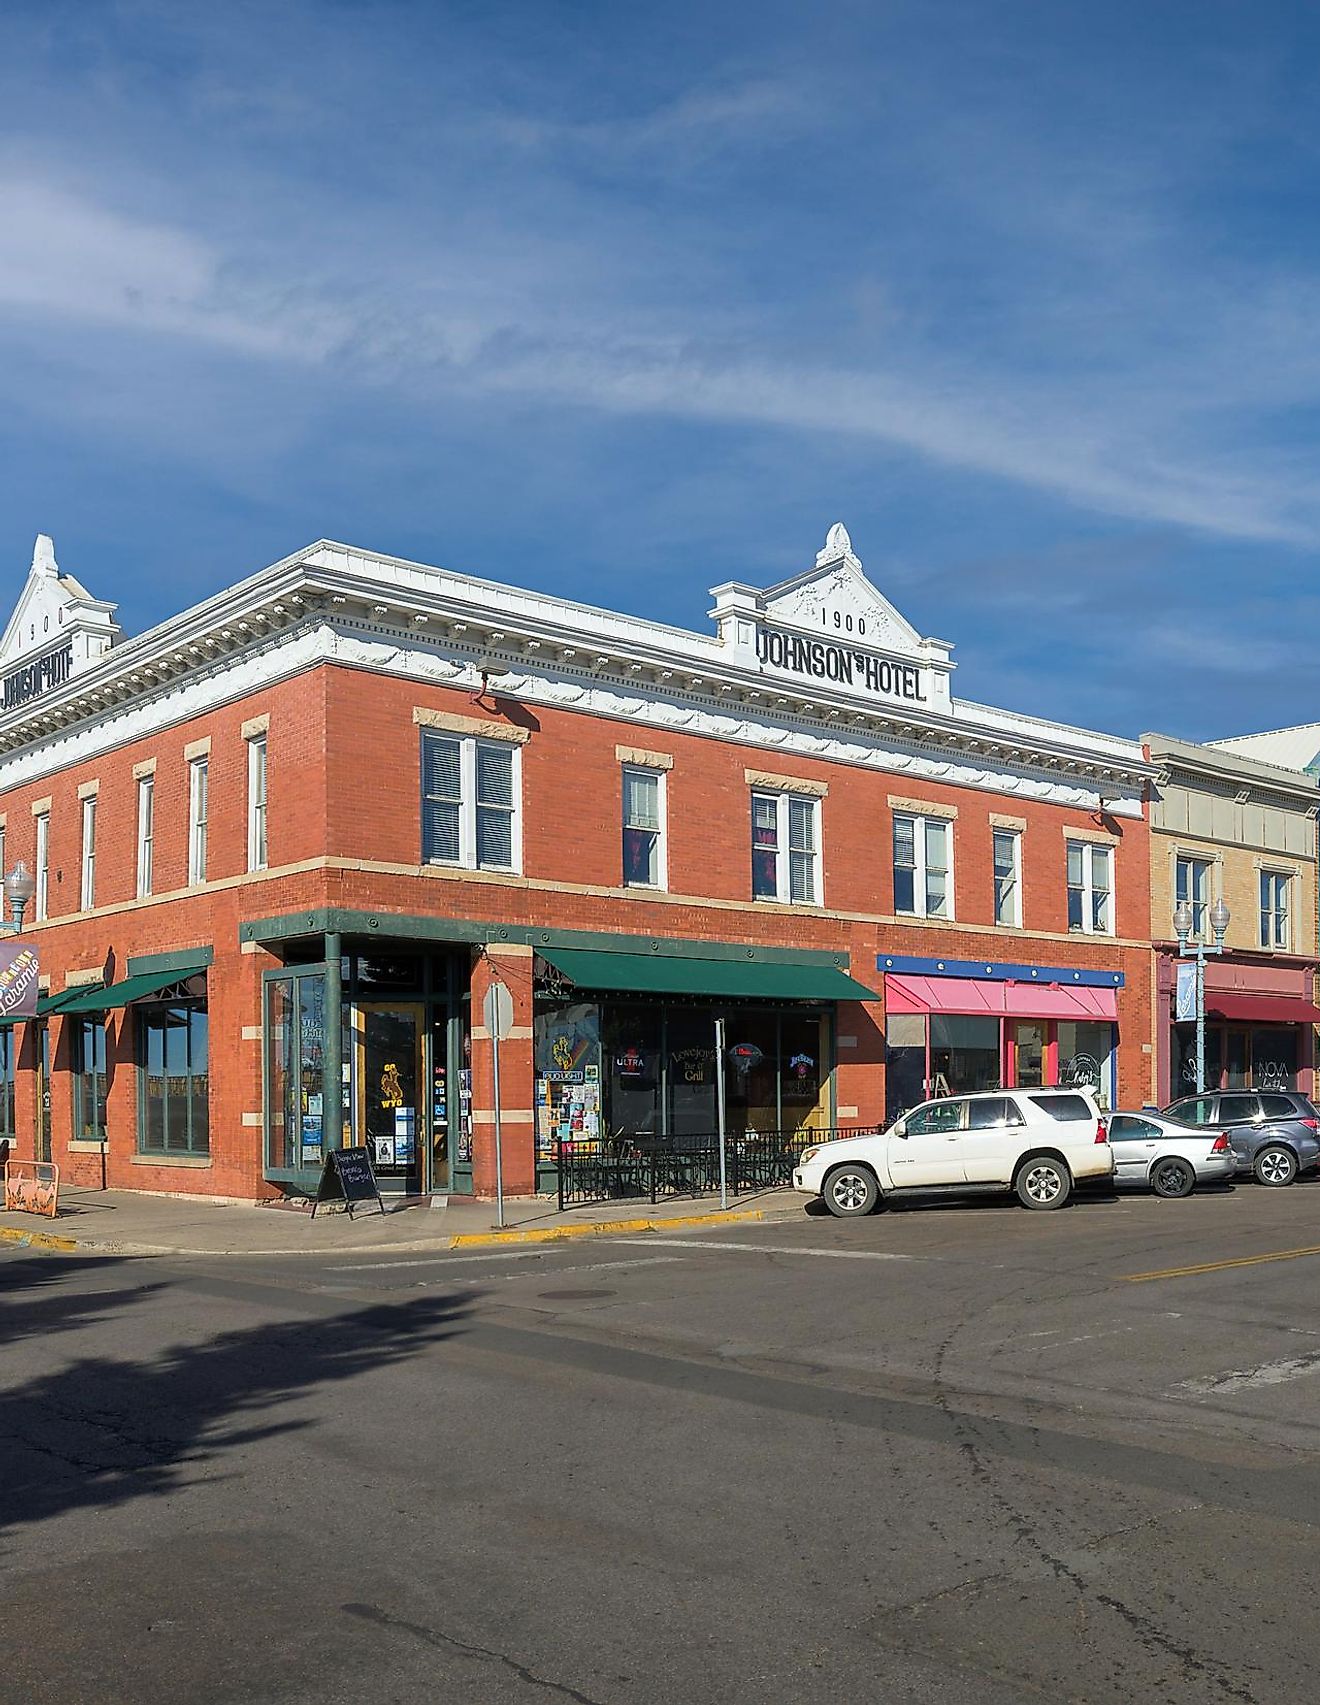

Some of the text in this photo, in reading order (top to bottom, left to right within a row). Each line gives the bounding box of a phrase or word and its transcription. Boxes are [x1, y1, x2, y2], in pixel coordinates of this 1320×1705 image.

[822, 607, 866, 635] 1900
[865, 656, 928, 702] HOTEL
[384, 1063, 396, 1072] GO
[616, 1058, 644, 1067] ULTRA
[1258, 1061, 1289, 1077] NOVA
[381, 1099, 403, 1109] WYO
